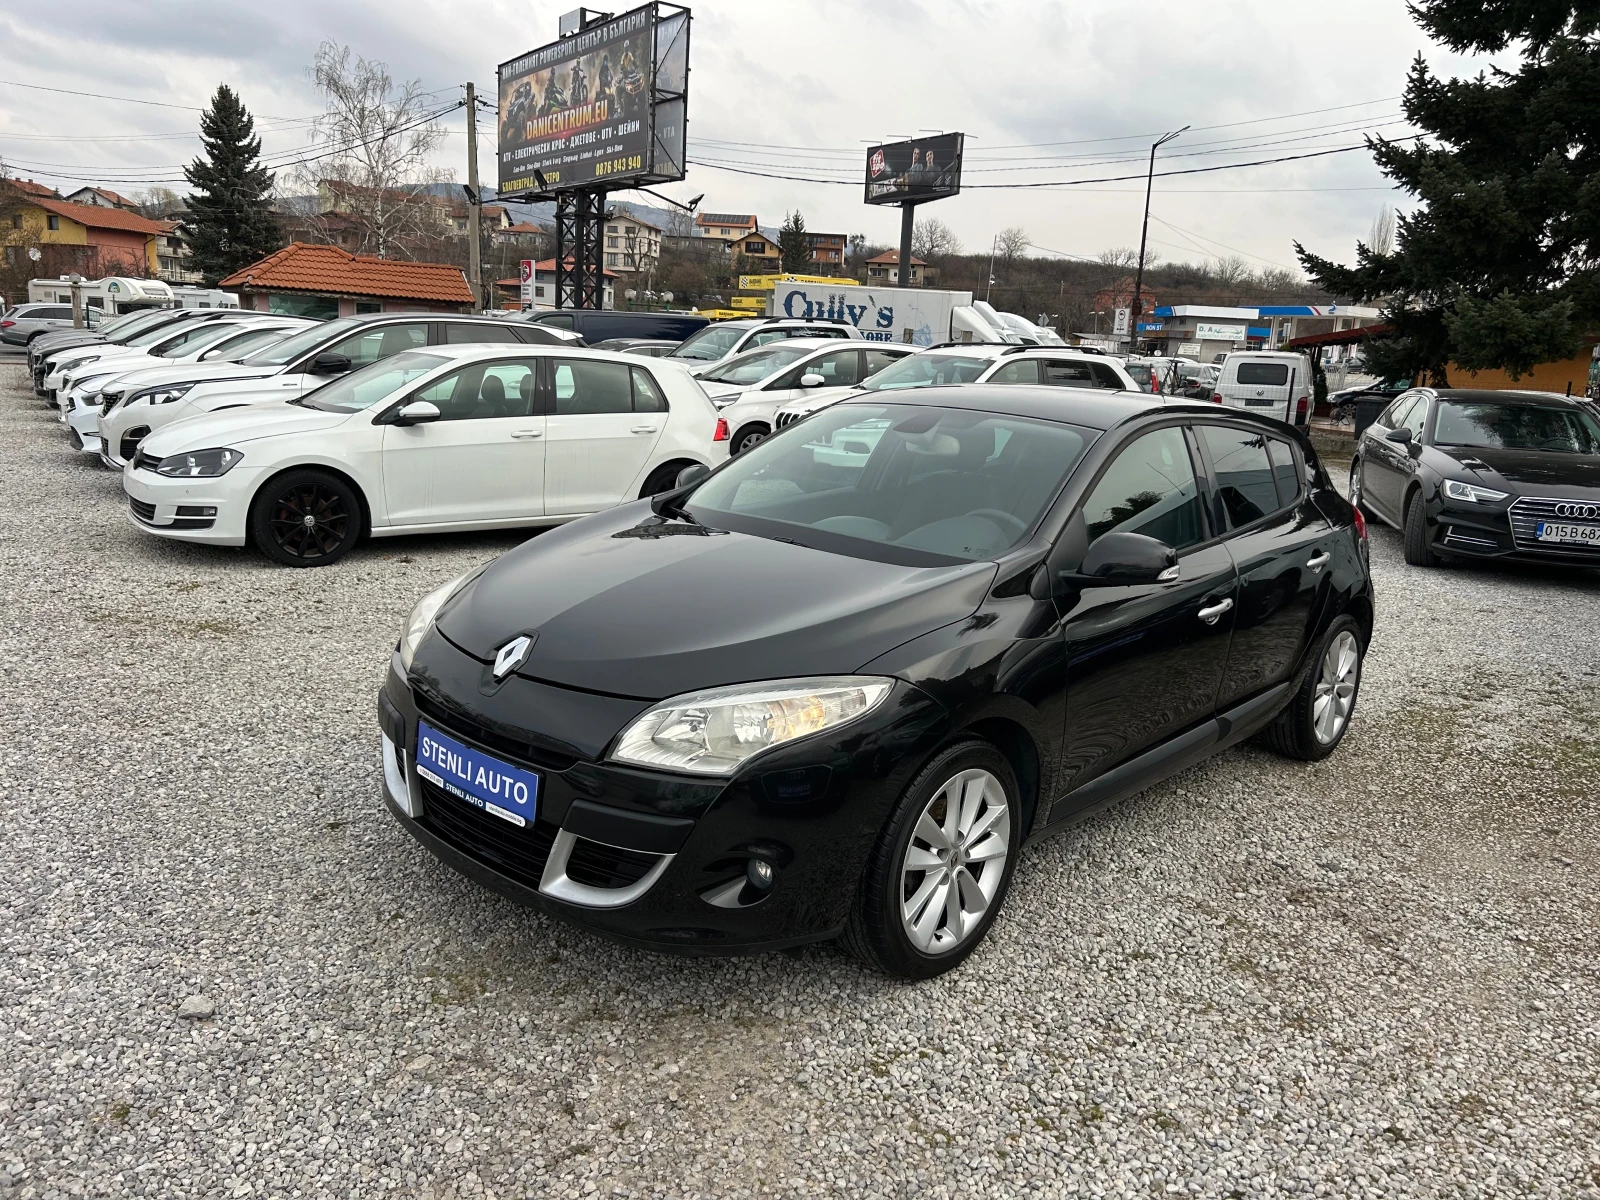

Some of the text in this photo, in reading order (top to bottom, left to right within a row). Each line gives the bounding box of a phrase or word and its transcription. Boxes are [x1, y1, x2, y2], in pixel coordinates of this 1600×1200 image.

[540, 40, 576, 65] POWERSPORT
[577, 29, 602, 53] ЦЕНТЪР
[603, 28, 608, 41] В
[609, 11, 646, 39] БЪЛГАРИЯ
[526, 100, 608, 139] DANICENTRUM.EU
[515, 142, 551, 160] ЕЛЕКТРИЧЕСКИ
[552, 138, 565, 151] КРОС
[570, 131, 596, 149] ДЖЕТОВЕ
[602, 127, 613, 140] UTV
[618, 120, 640, 136] ШЕЙНИ
[502, 176, 533, 193] БЛАГОЕВГРАД
[595, 160, 612, 176] 0876
[613, 157, 626, 172] 943
[628, 155, 641, 170] 940
[422, 736, 528, 804] STENLI AUTO
[446, 782, 464, 799] STENLI
[465, 794, 484, 807] AUTO
